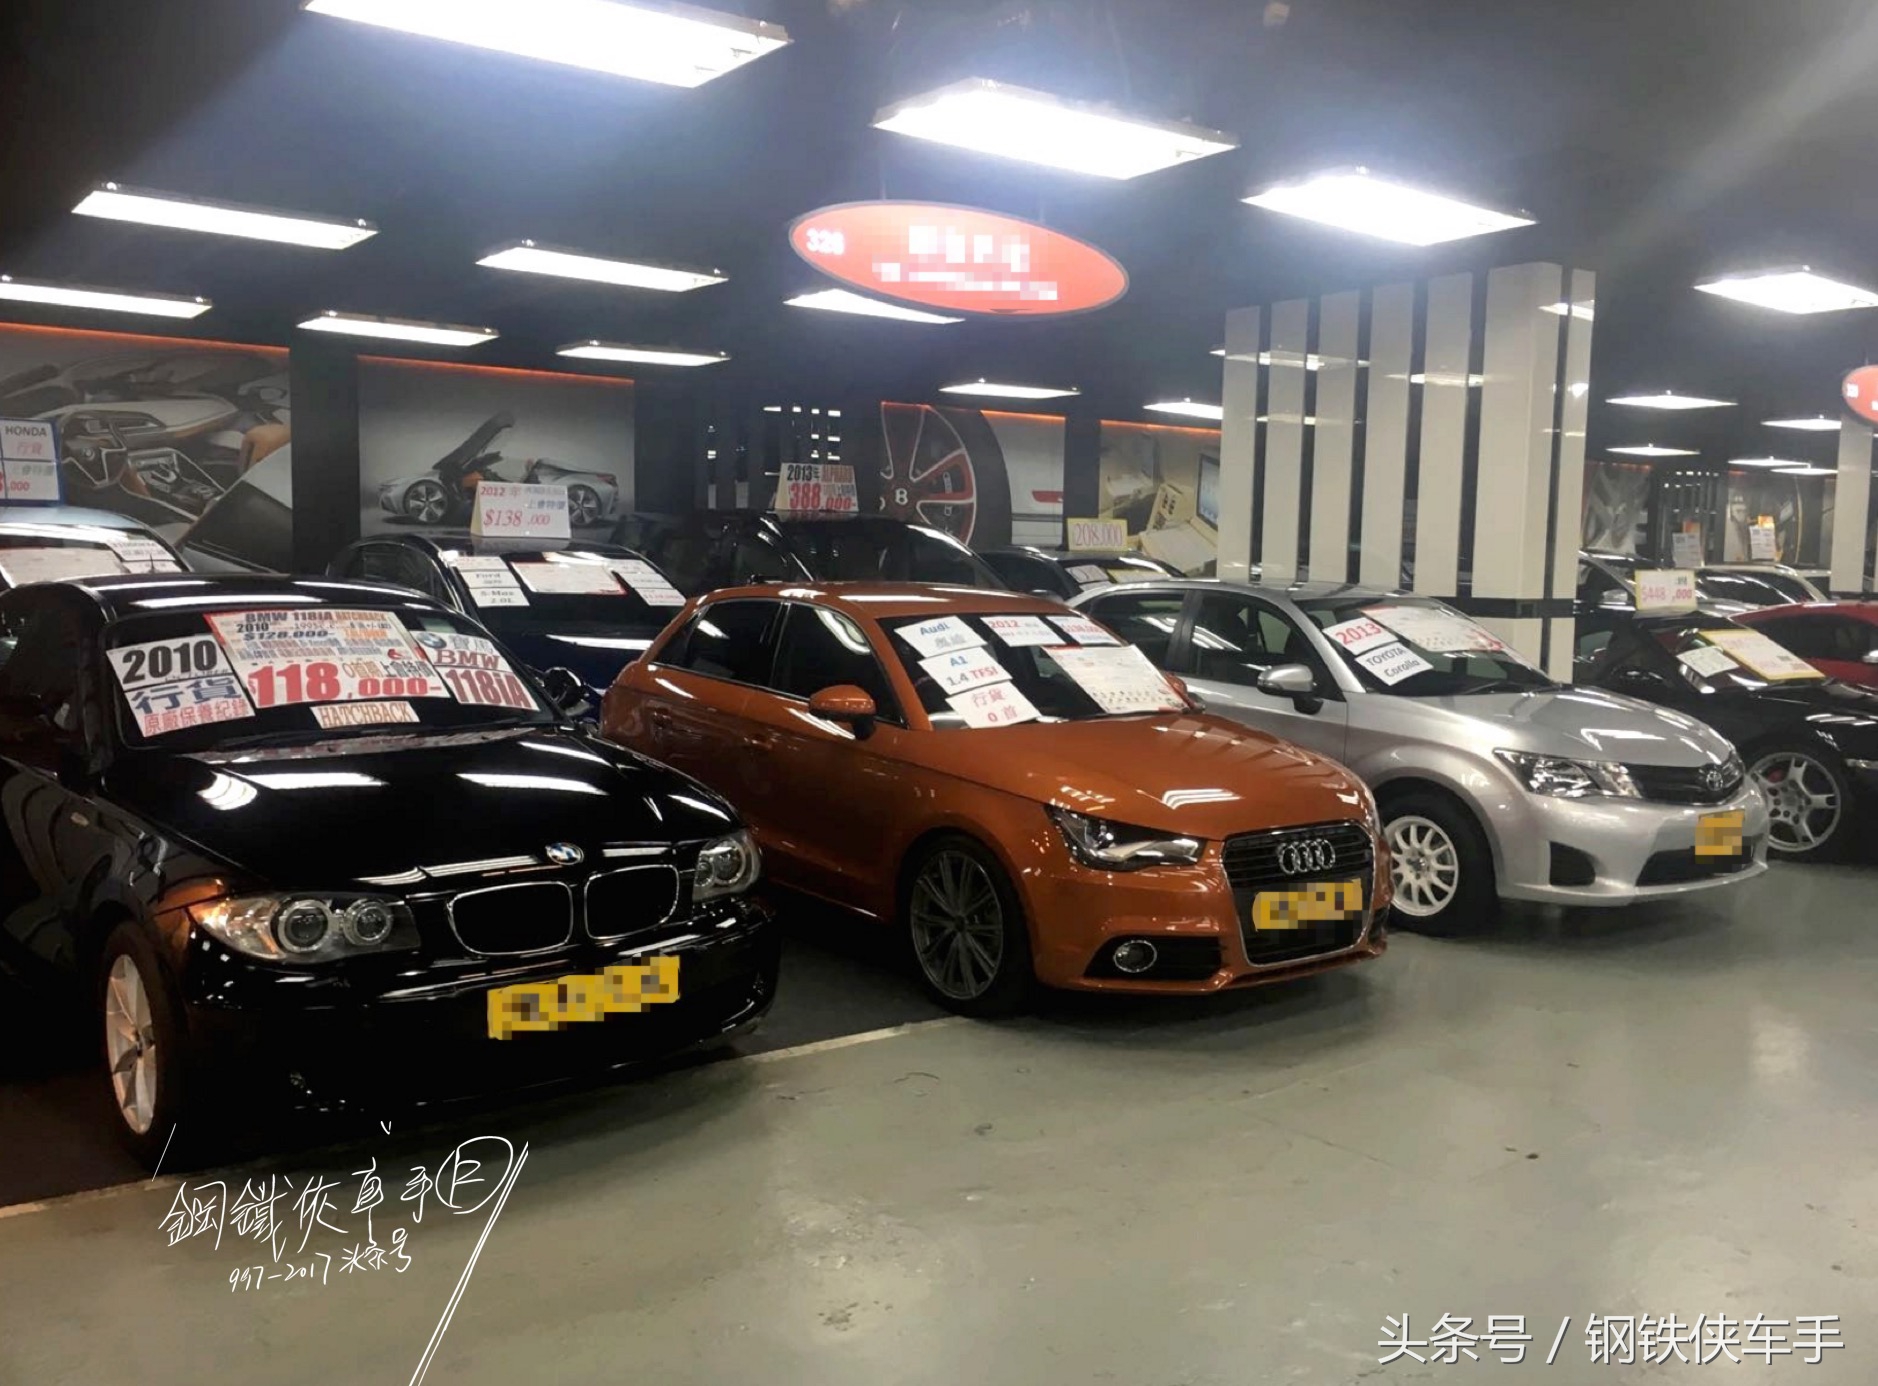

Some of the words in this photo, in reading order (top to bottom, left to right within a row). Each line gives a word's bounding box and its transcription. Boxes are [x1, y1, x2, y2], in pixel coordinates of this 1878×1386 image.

[5, 425, 47, 436] HONDA
[245, 613, 288, 623] BMW
[989, 620, 1018, 629] 2012
[237, 623, 270, 633] 2010
[919, 622, 950, 636] Audi
[1335, 622, 1382, 646] 2013
[122, 640, 217, 684] 2010
[434, 649, 501, 669] BMW
[949, 655, 968, 667] A1
[1366, 648, 1404, 666] TOYOTA
[946, 673, 969, 687] 1.4
[969, 666, 998, 680] TFSI
[1384, 659, 1420, 678] Corolla
[131, 677, 242, 714] 行貨
[444, 669, 532, 709] 118iA
[317, 702, 412, 727] HATCHBACK
